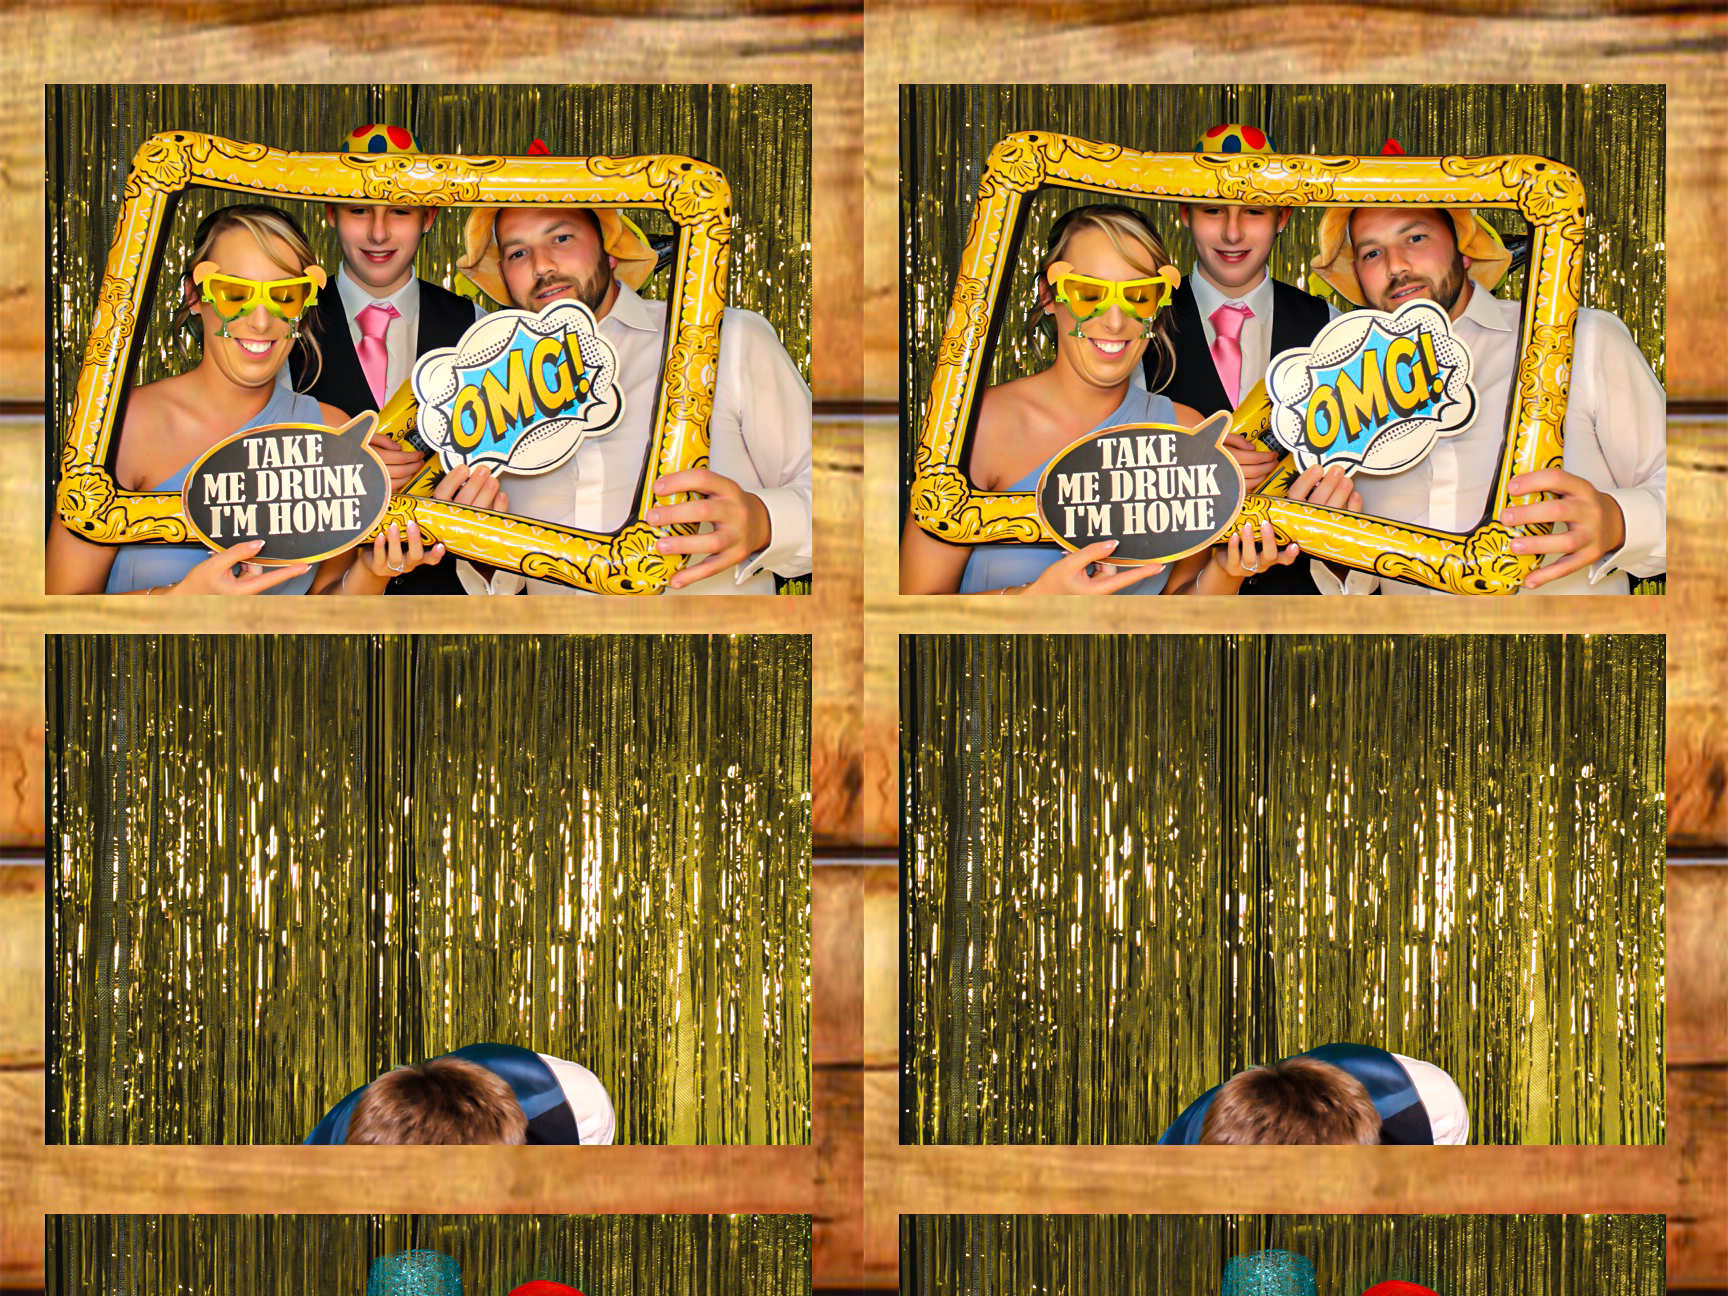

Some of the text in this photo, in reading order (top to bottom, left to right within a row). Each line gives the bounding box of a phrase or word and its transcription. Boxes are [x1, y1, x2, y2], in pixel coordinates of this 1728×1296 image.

[451, 332, 591, 450] OMG!
[1305, 332, 1445, 450] OMG!
[243, 434, 323, 470] TAKE
[1097, 434, 1177, 470] TAKE
[203, 464, 367, 505] ME DRUNK
[1057, 464, 1221, 505] ME DRUNK
[210, 498, 362, 538] I'M HOME
[1064, 498, 1216, 538] I'M HOME
